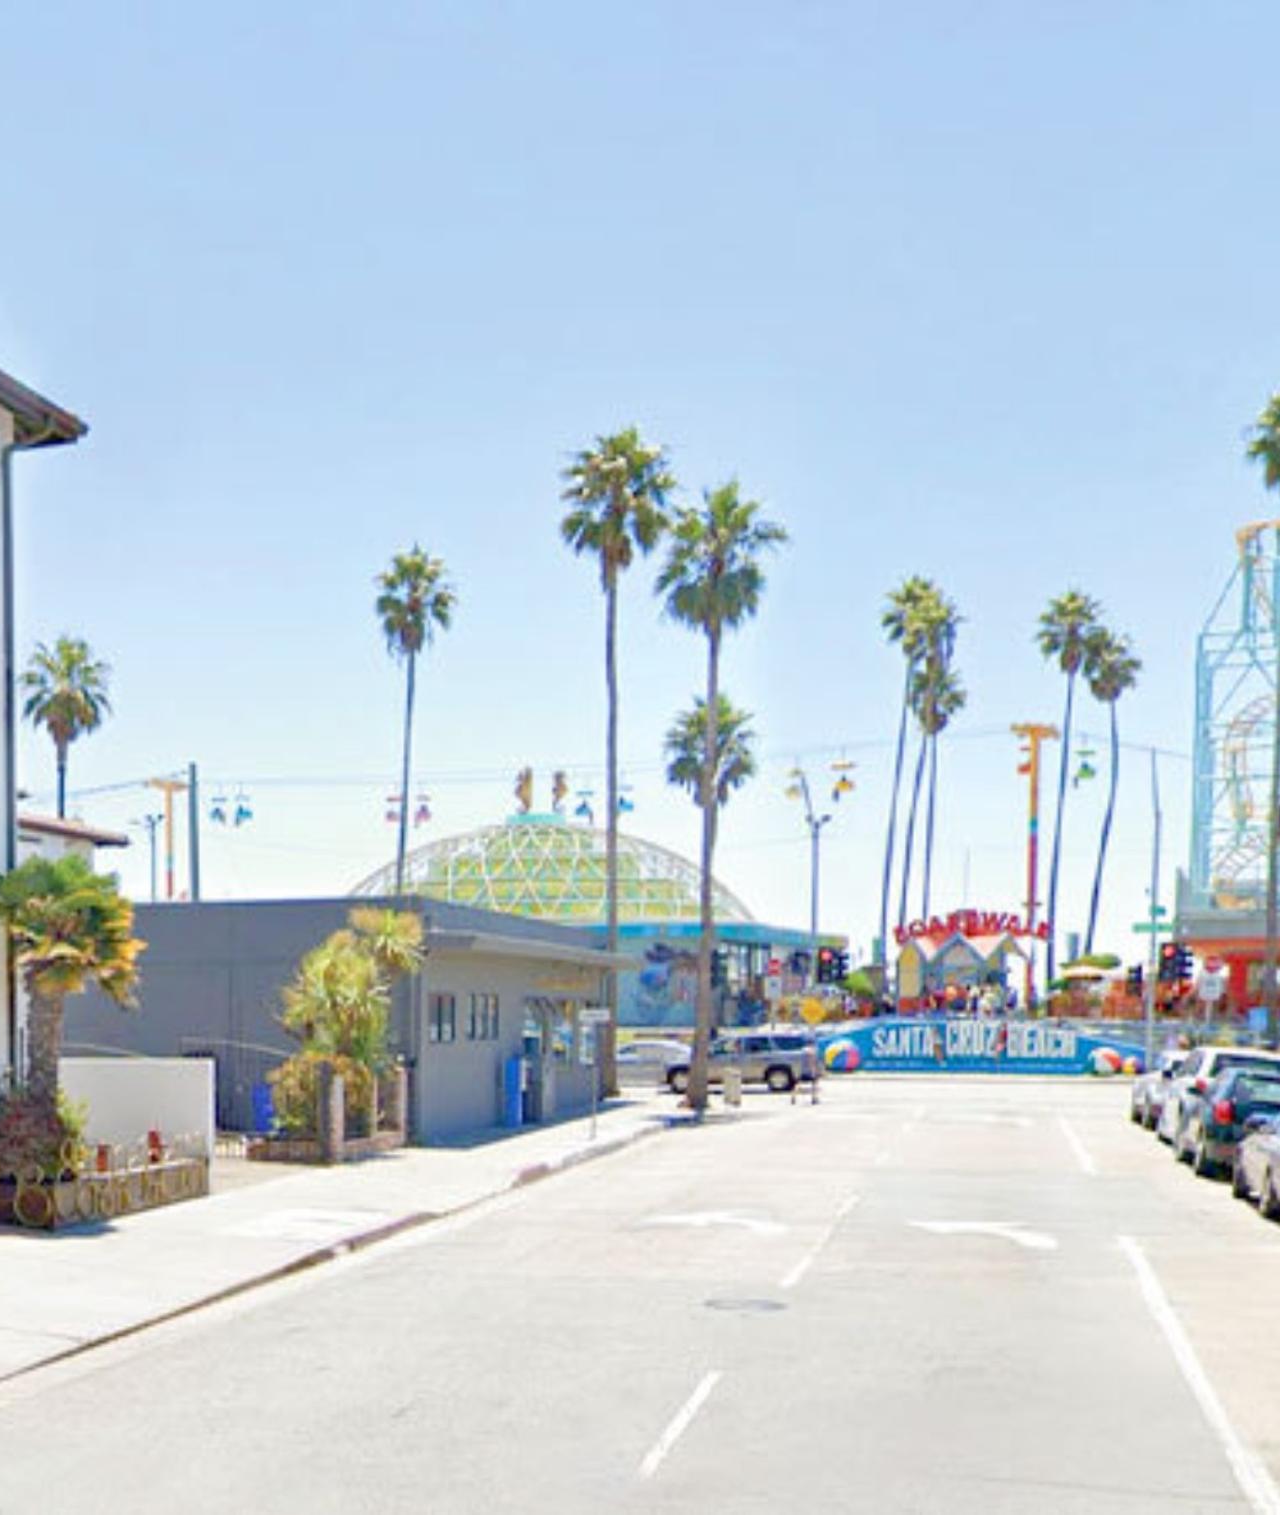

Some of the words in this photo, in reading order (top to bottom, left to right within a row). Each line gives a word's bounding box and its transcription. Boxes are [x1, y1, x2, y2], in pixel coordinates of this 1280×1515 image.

[894, 909, 1050, 946] BOARDWALK
[872, 1025, 936, 1058] SANTA
[946, 1020, 998, 1055] CRUZ
[1007, 1022, 1076, 1058] BEACH
